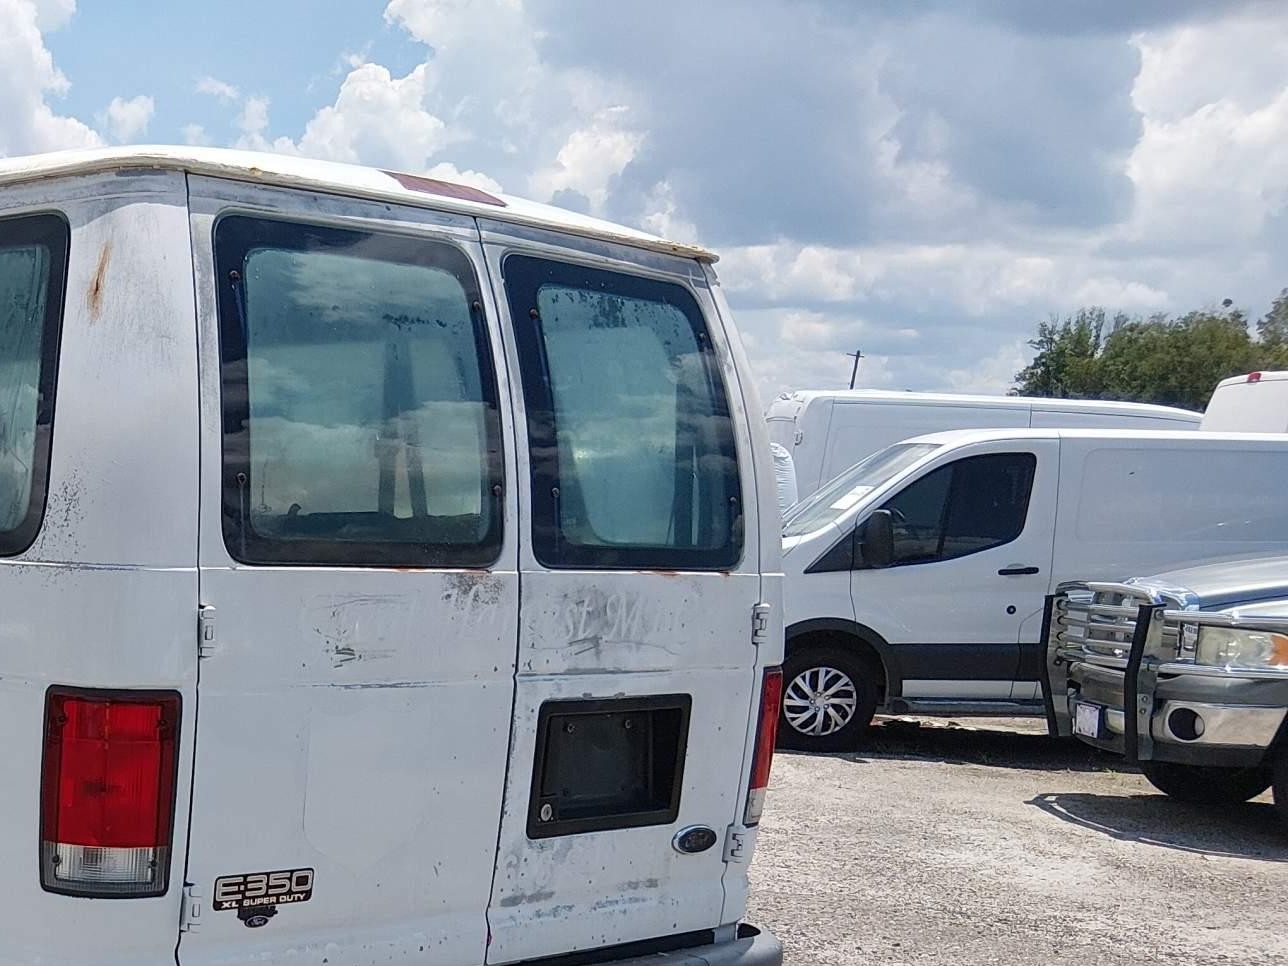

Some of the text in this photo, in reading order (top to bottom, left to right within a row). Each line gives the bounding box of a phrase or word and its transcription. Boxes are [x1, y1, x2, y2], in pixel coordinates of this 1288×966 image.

[221, 893, 305, 909] XL SUPER DUTY
